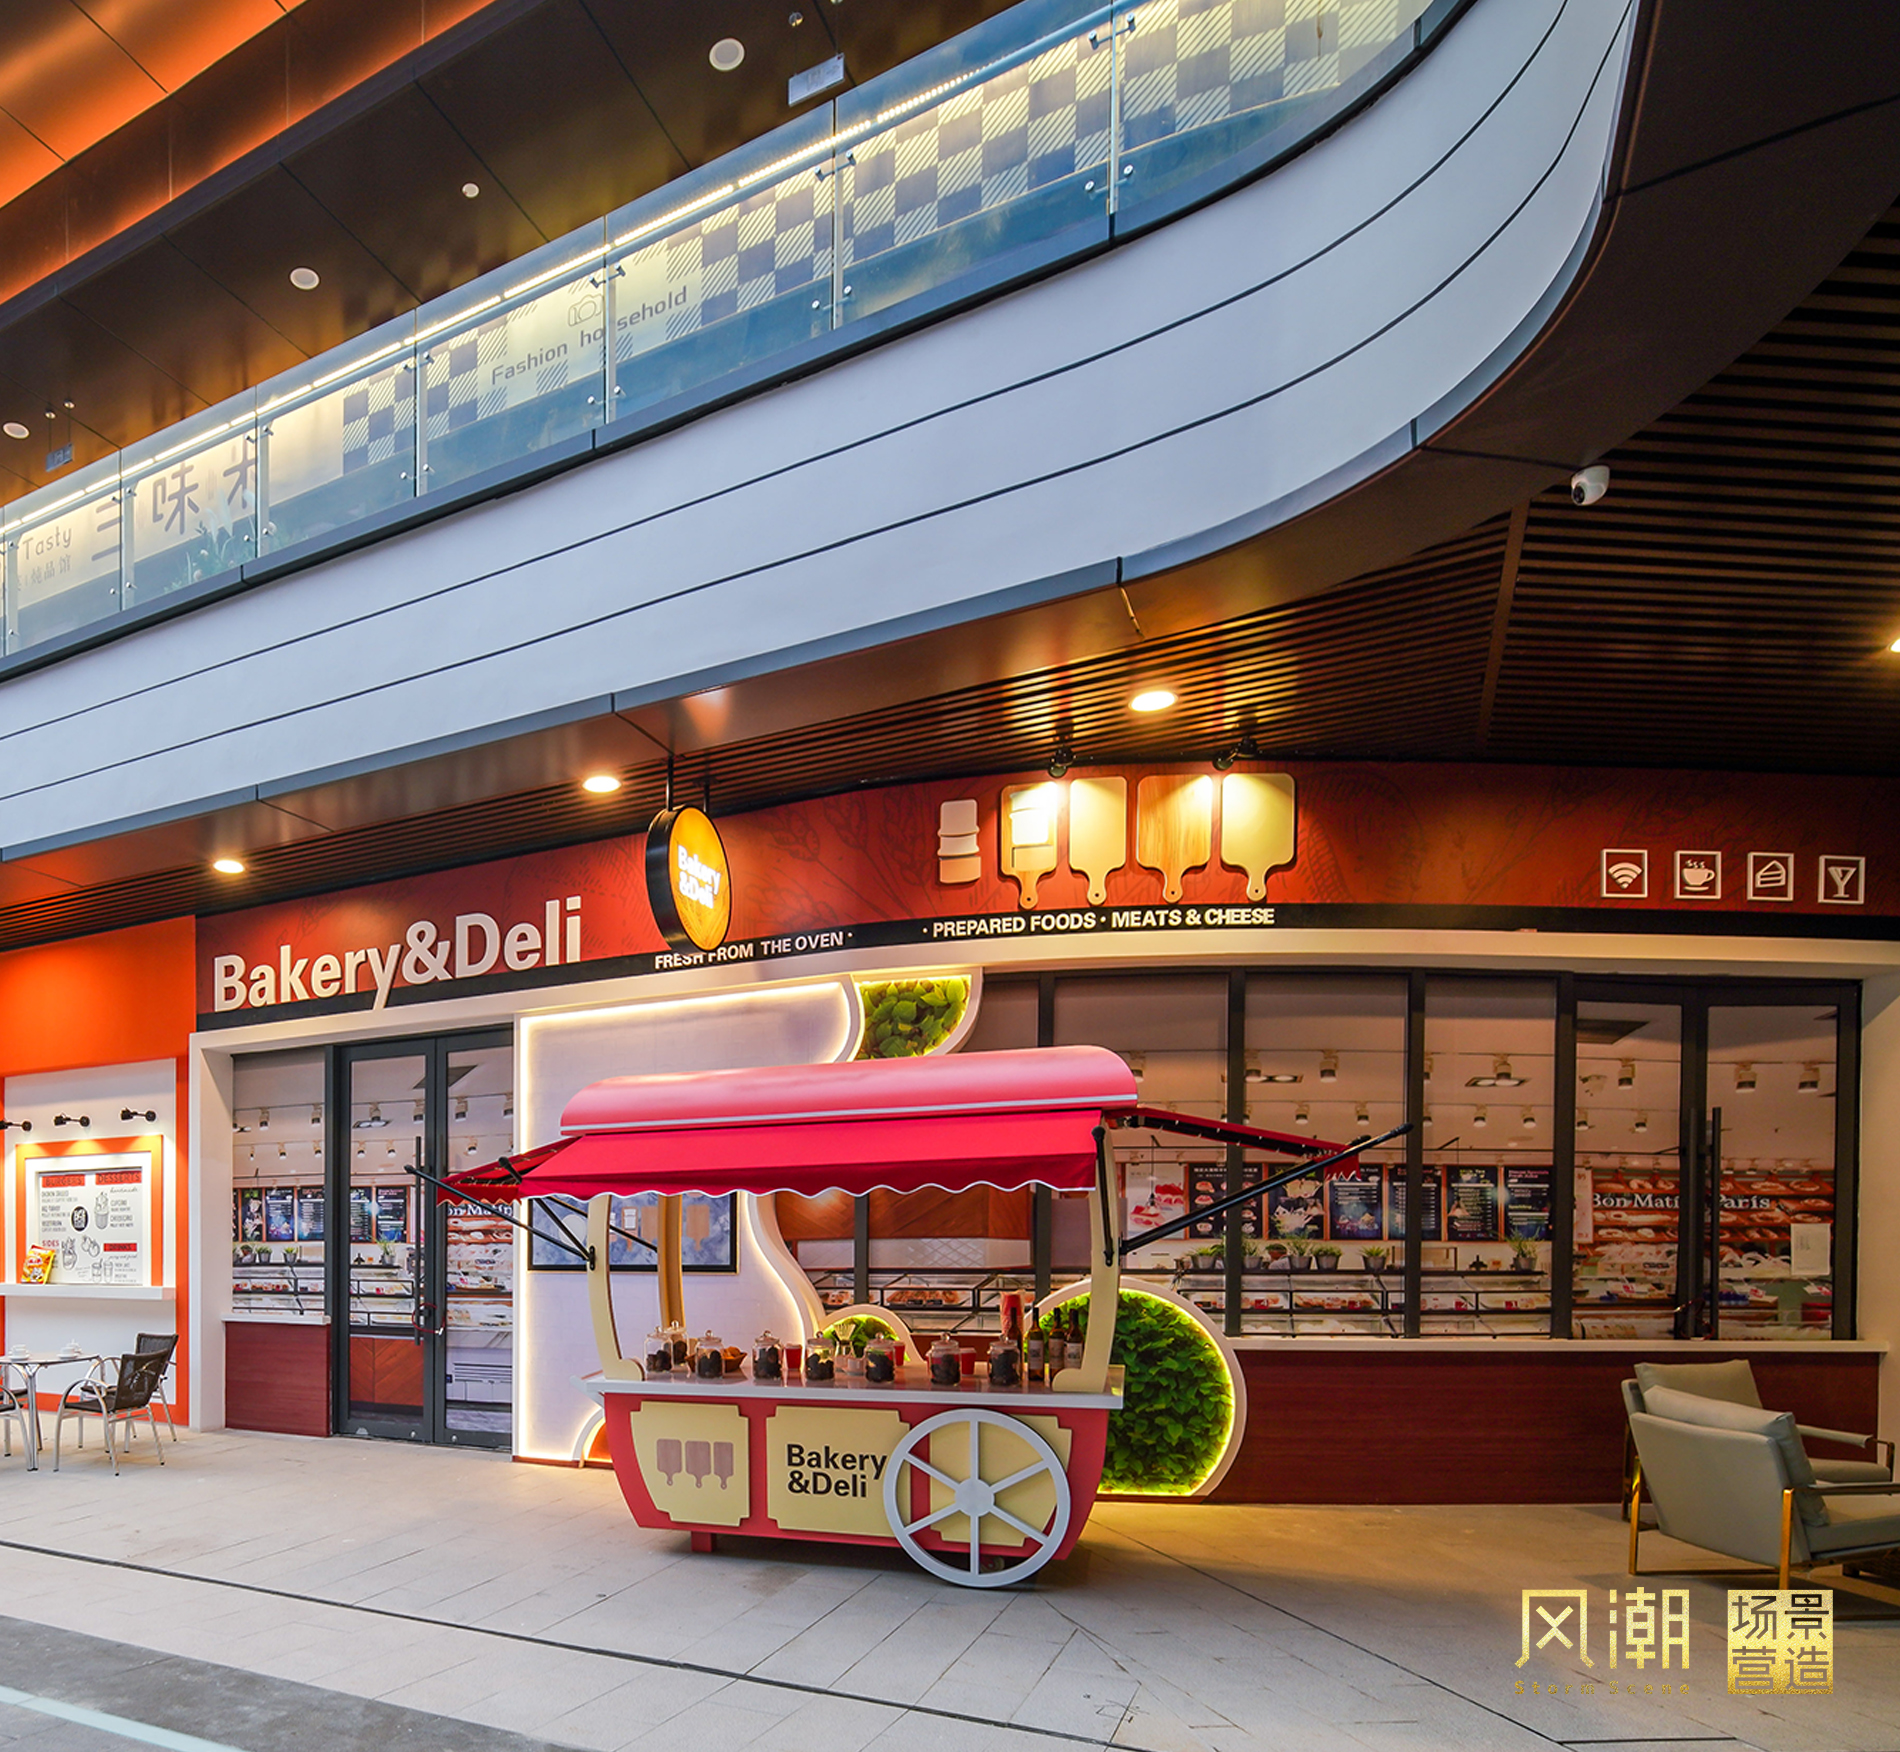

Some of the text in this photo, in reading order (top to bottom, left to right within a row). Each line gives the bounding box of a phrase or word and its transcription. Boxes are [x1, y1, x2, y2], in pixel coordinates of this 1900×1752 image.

[491, 285, 687, 385] Fashion hosehold
[22, 526, 72, 560] Tasty
[678, 844, 721, 895] Bakery
[679, 870, 714, 909] &Deli
[932, 907, 1276, 938] PREPARED FOODS MEATS & CHEESE
[213, 894, 582, 1012] Bakery&Deli
[708, 943, 754, 963] FROM
[760, 937, 792, 955] THE
[794, 930, 844, 951] OVEN
[98, 1172, 141, 1184] DESSERTS
[42, 1240, 60, 1248] SIDES
[786, 1443, 888, 1479] Bakery
[787, 1470, 868, 1498] &Deli
